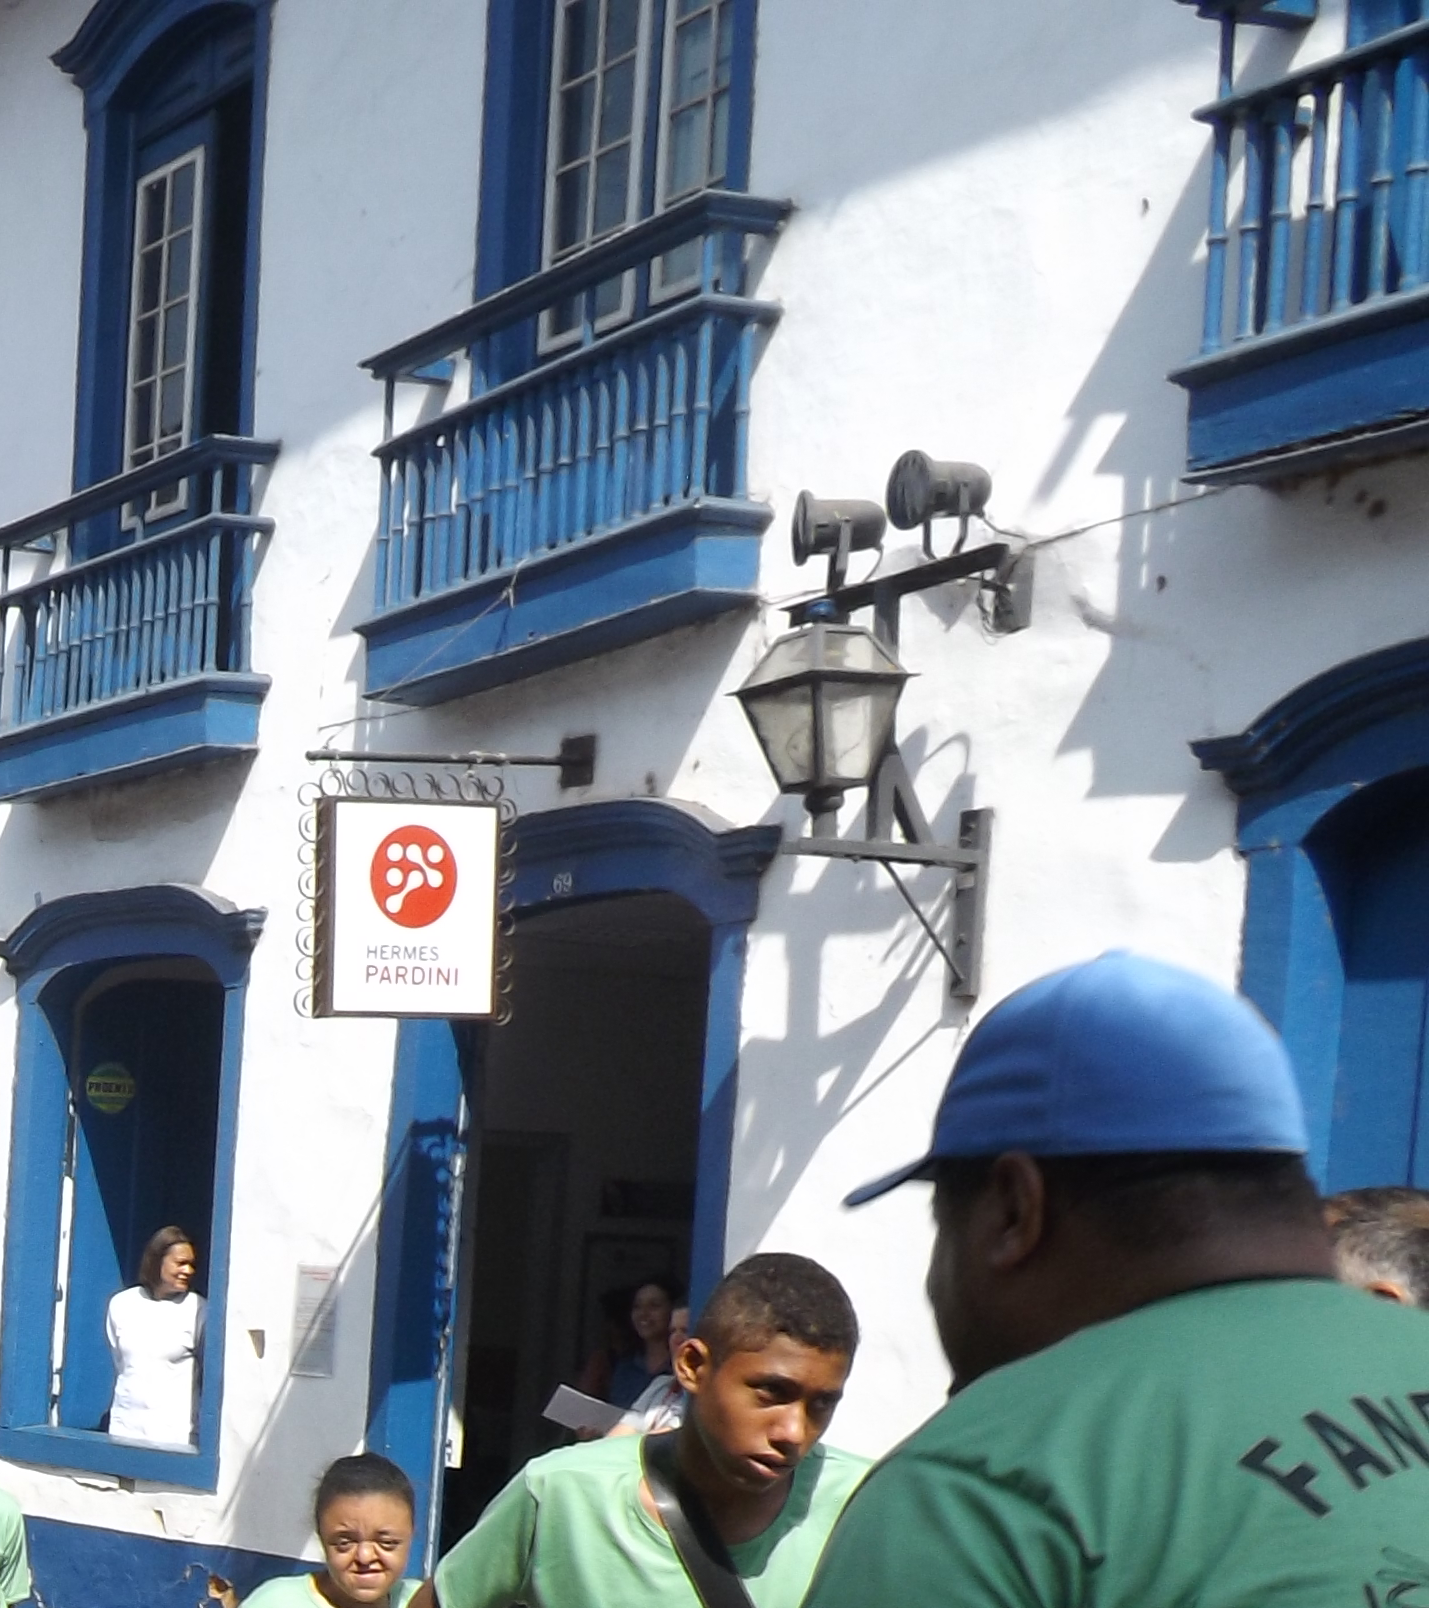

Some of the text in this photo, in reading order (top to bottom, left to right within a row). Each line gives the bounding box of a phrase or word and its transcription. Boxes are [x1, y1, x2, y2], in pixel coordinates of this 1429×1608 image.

[552, 872, 573, 893] 69
[366, 944, 440, 961] HERMES
[365, 964, 460, 986] PARDINI
